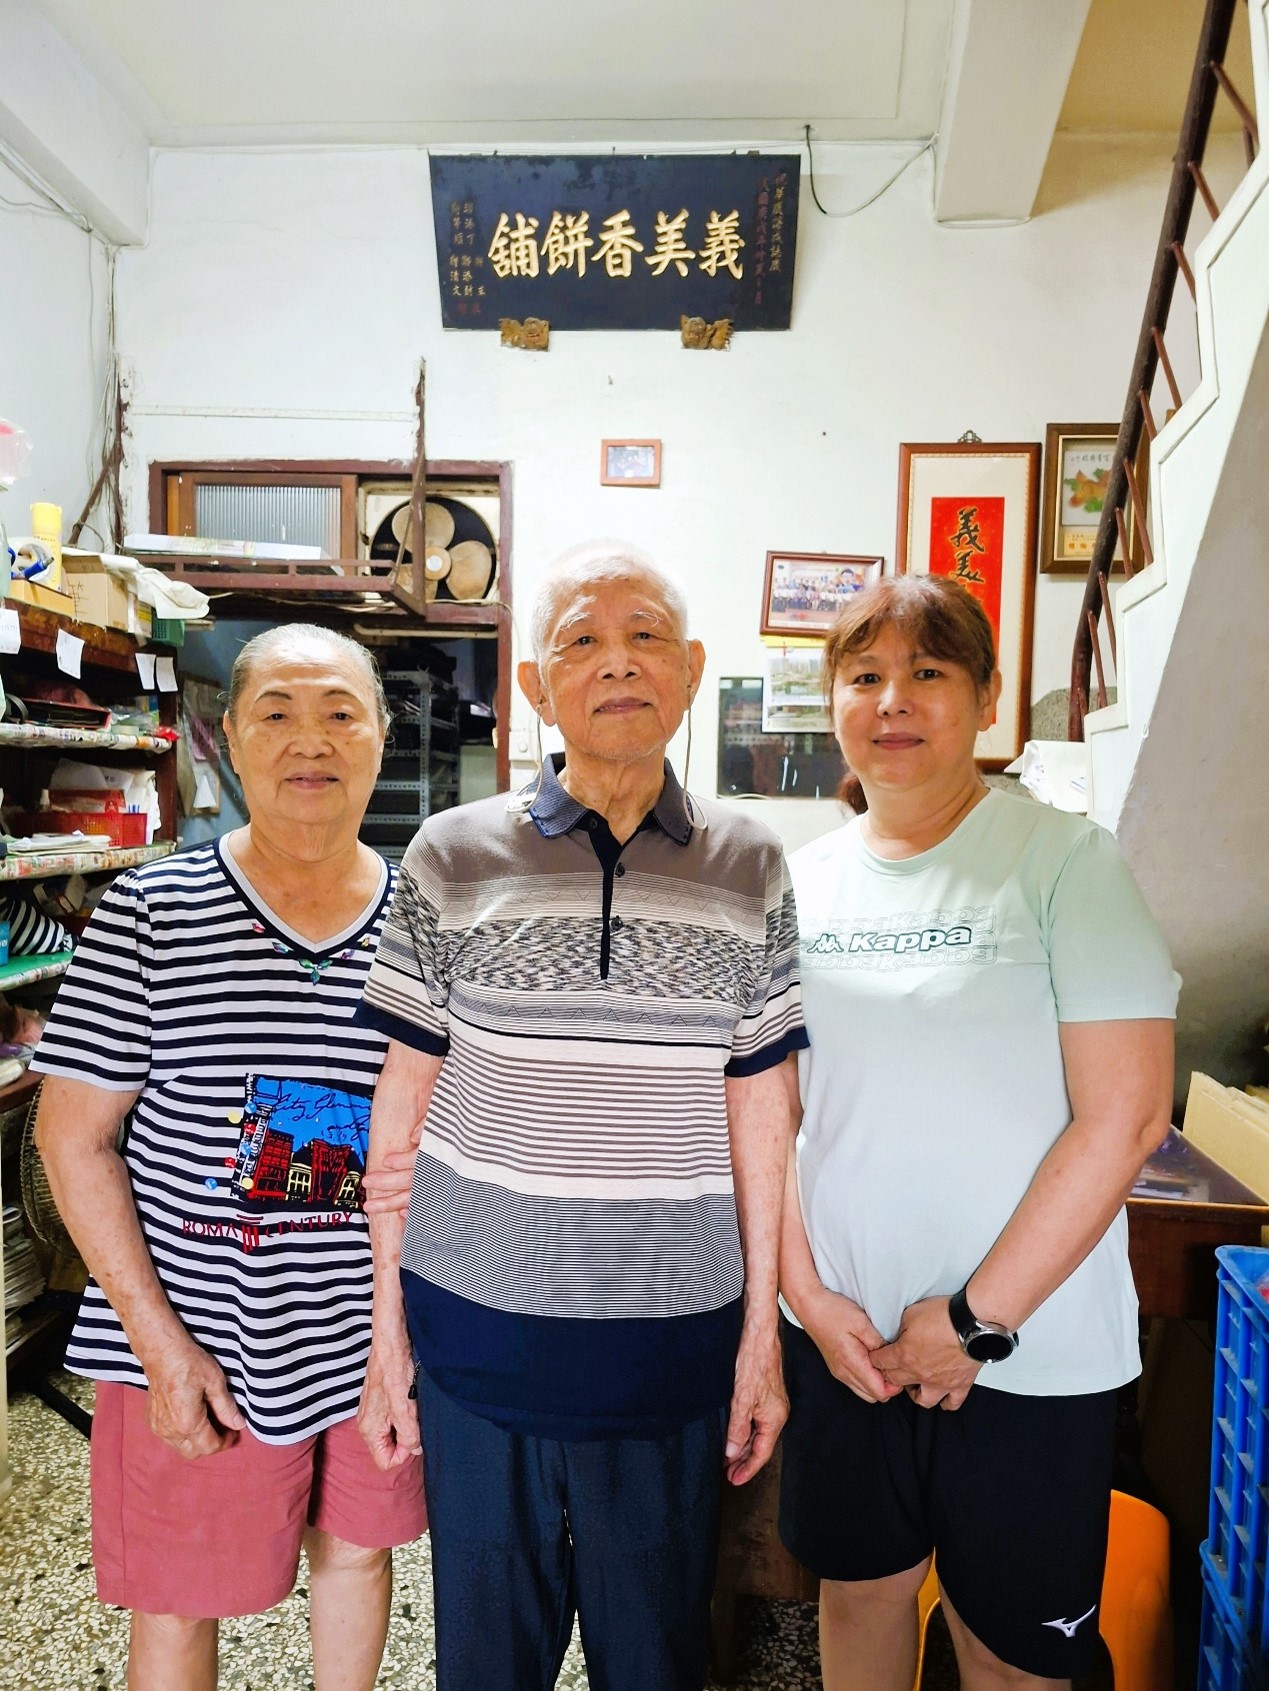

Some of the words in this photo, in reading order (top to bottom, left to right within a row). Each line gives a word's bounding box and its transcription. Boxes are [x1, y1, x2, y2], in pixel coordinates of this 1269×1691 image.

[848, 926, 972, 954] Kappa
[182, 1218, 238, 1238] ROMA
[265, 1211, 353, 1238] CENTURY
